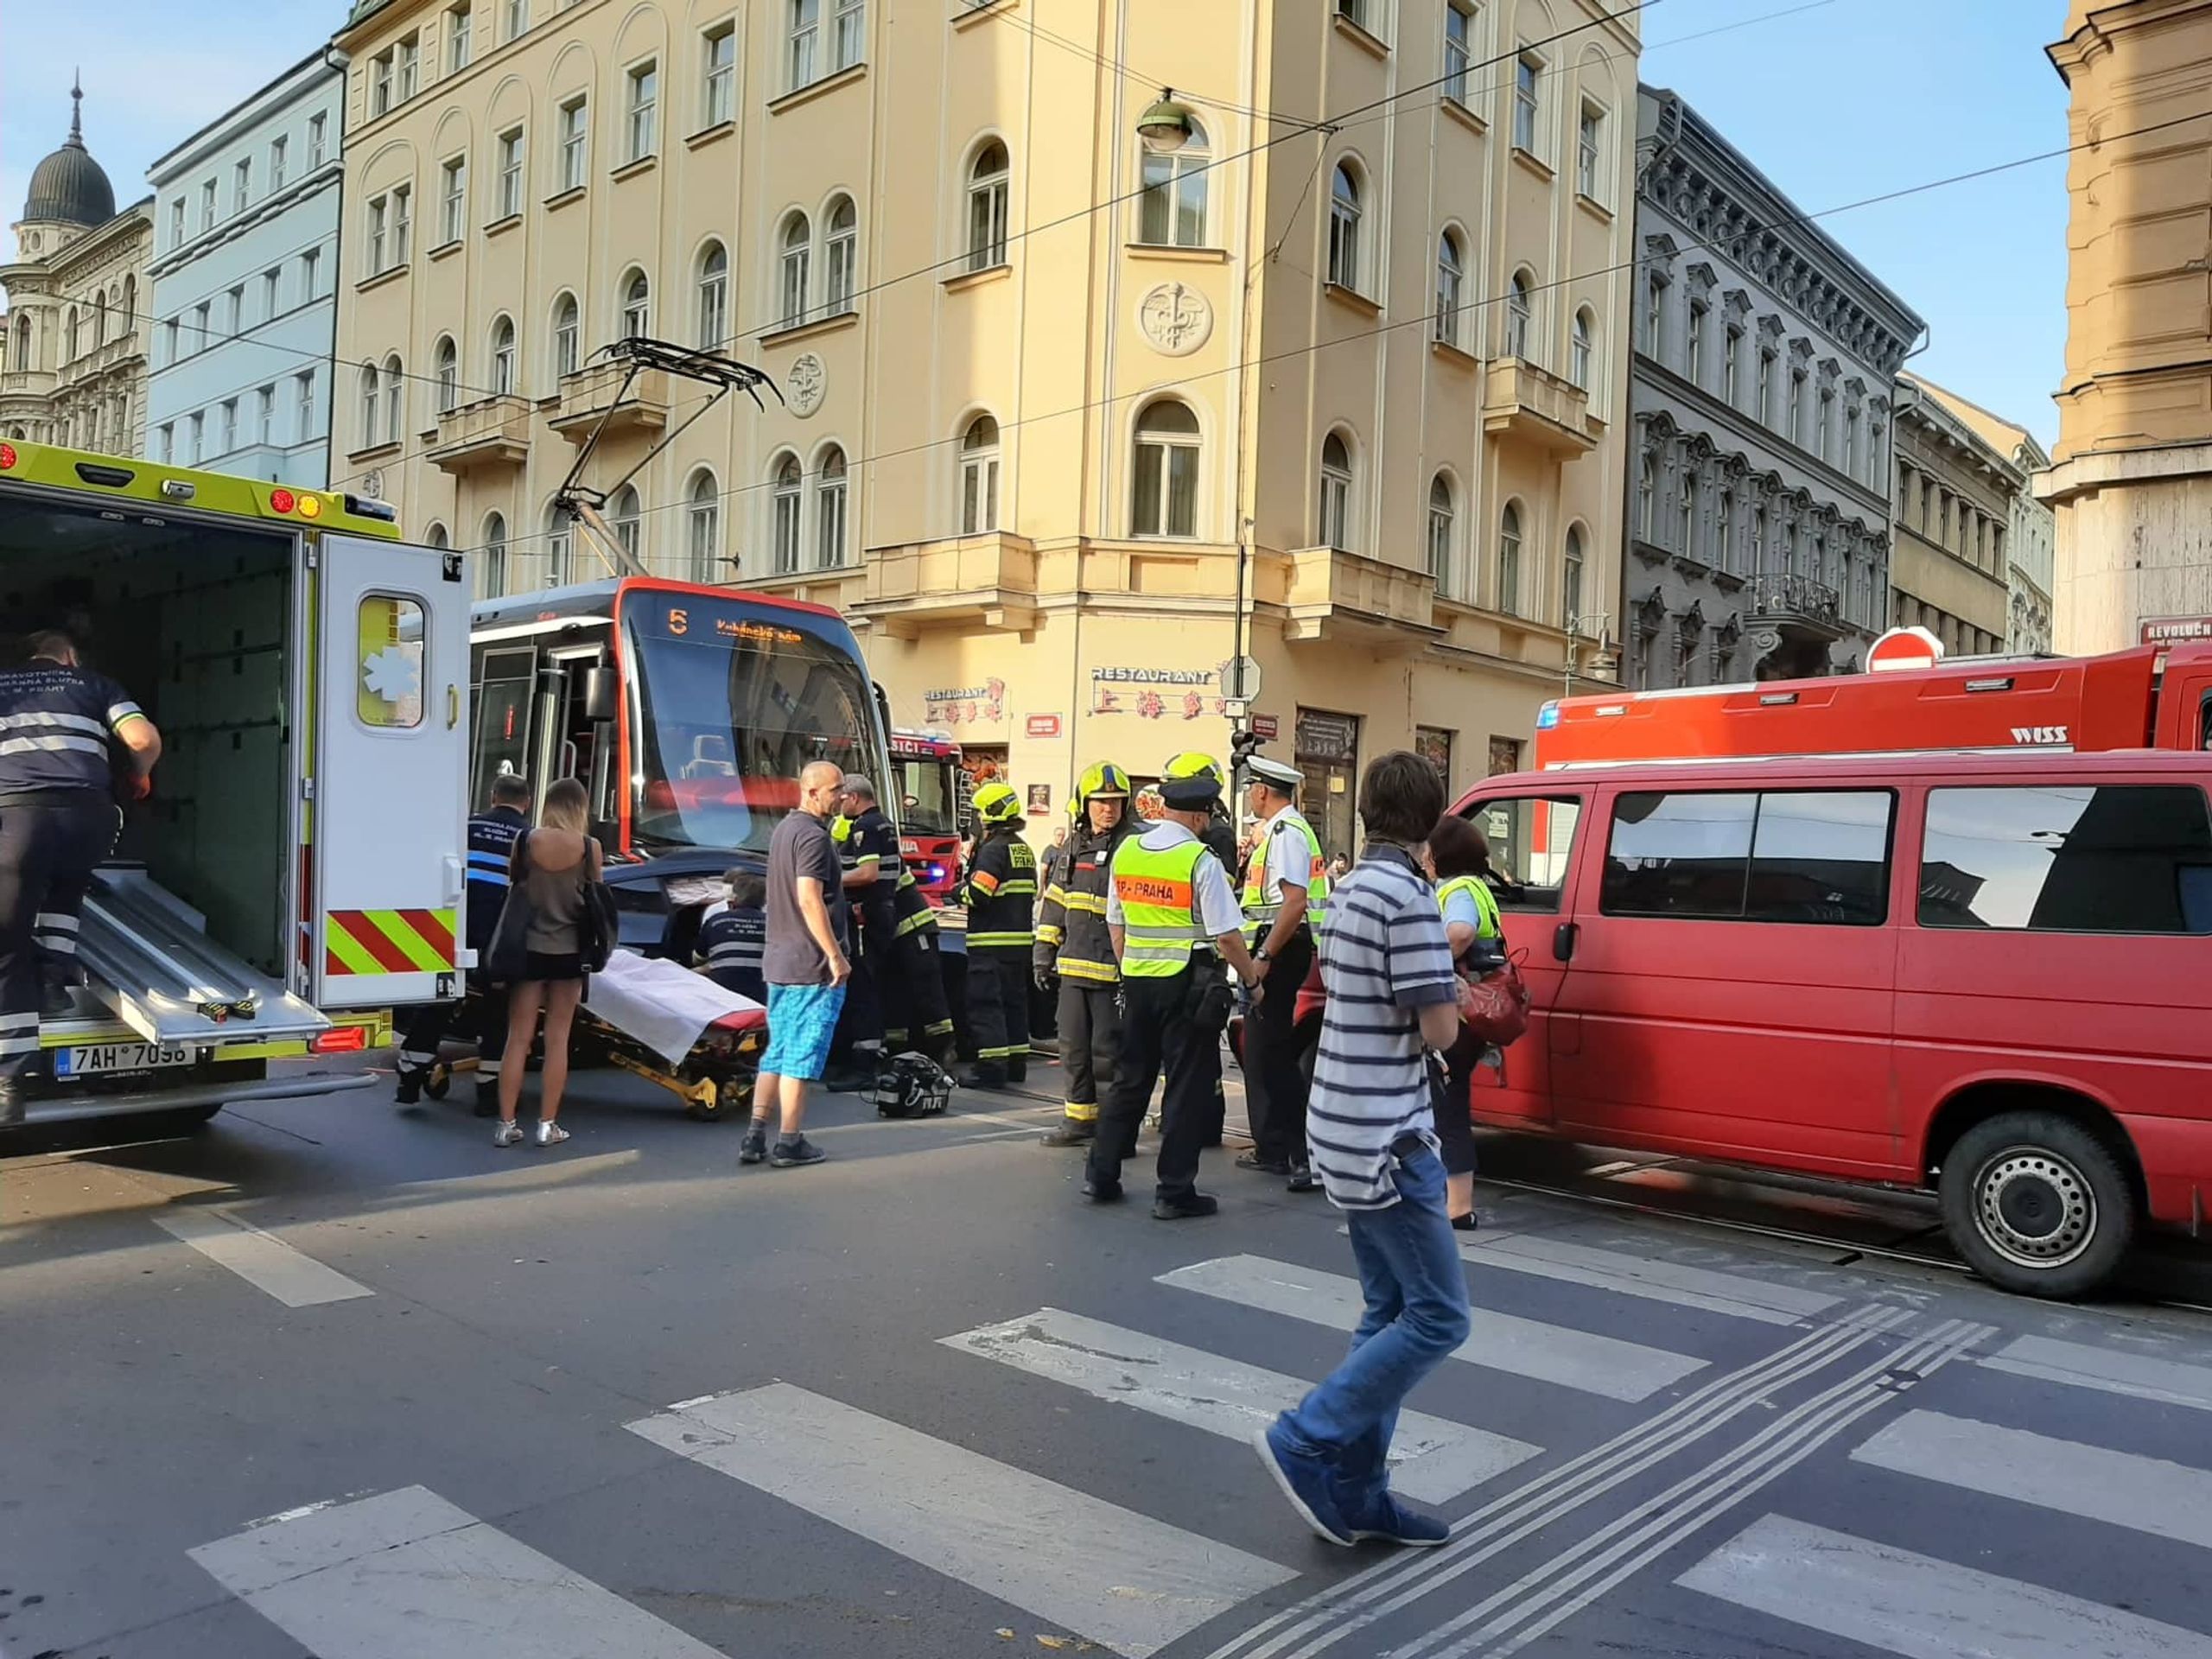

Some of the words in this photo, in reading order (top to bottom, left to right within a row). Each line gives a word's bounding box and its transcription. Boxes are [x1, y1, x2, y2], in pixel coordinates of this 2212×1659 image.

[1092, 667, 1210, 684] RESTAURANT
[2010, 726, 2068, 744] WISS
[1134, 882, 1174, 900] PRAHA
[76, 1047, 117, 1071] 7AH
